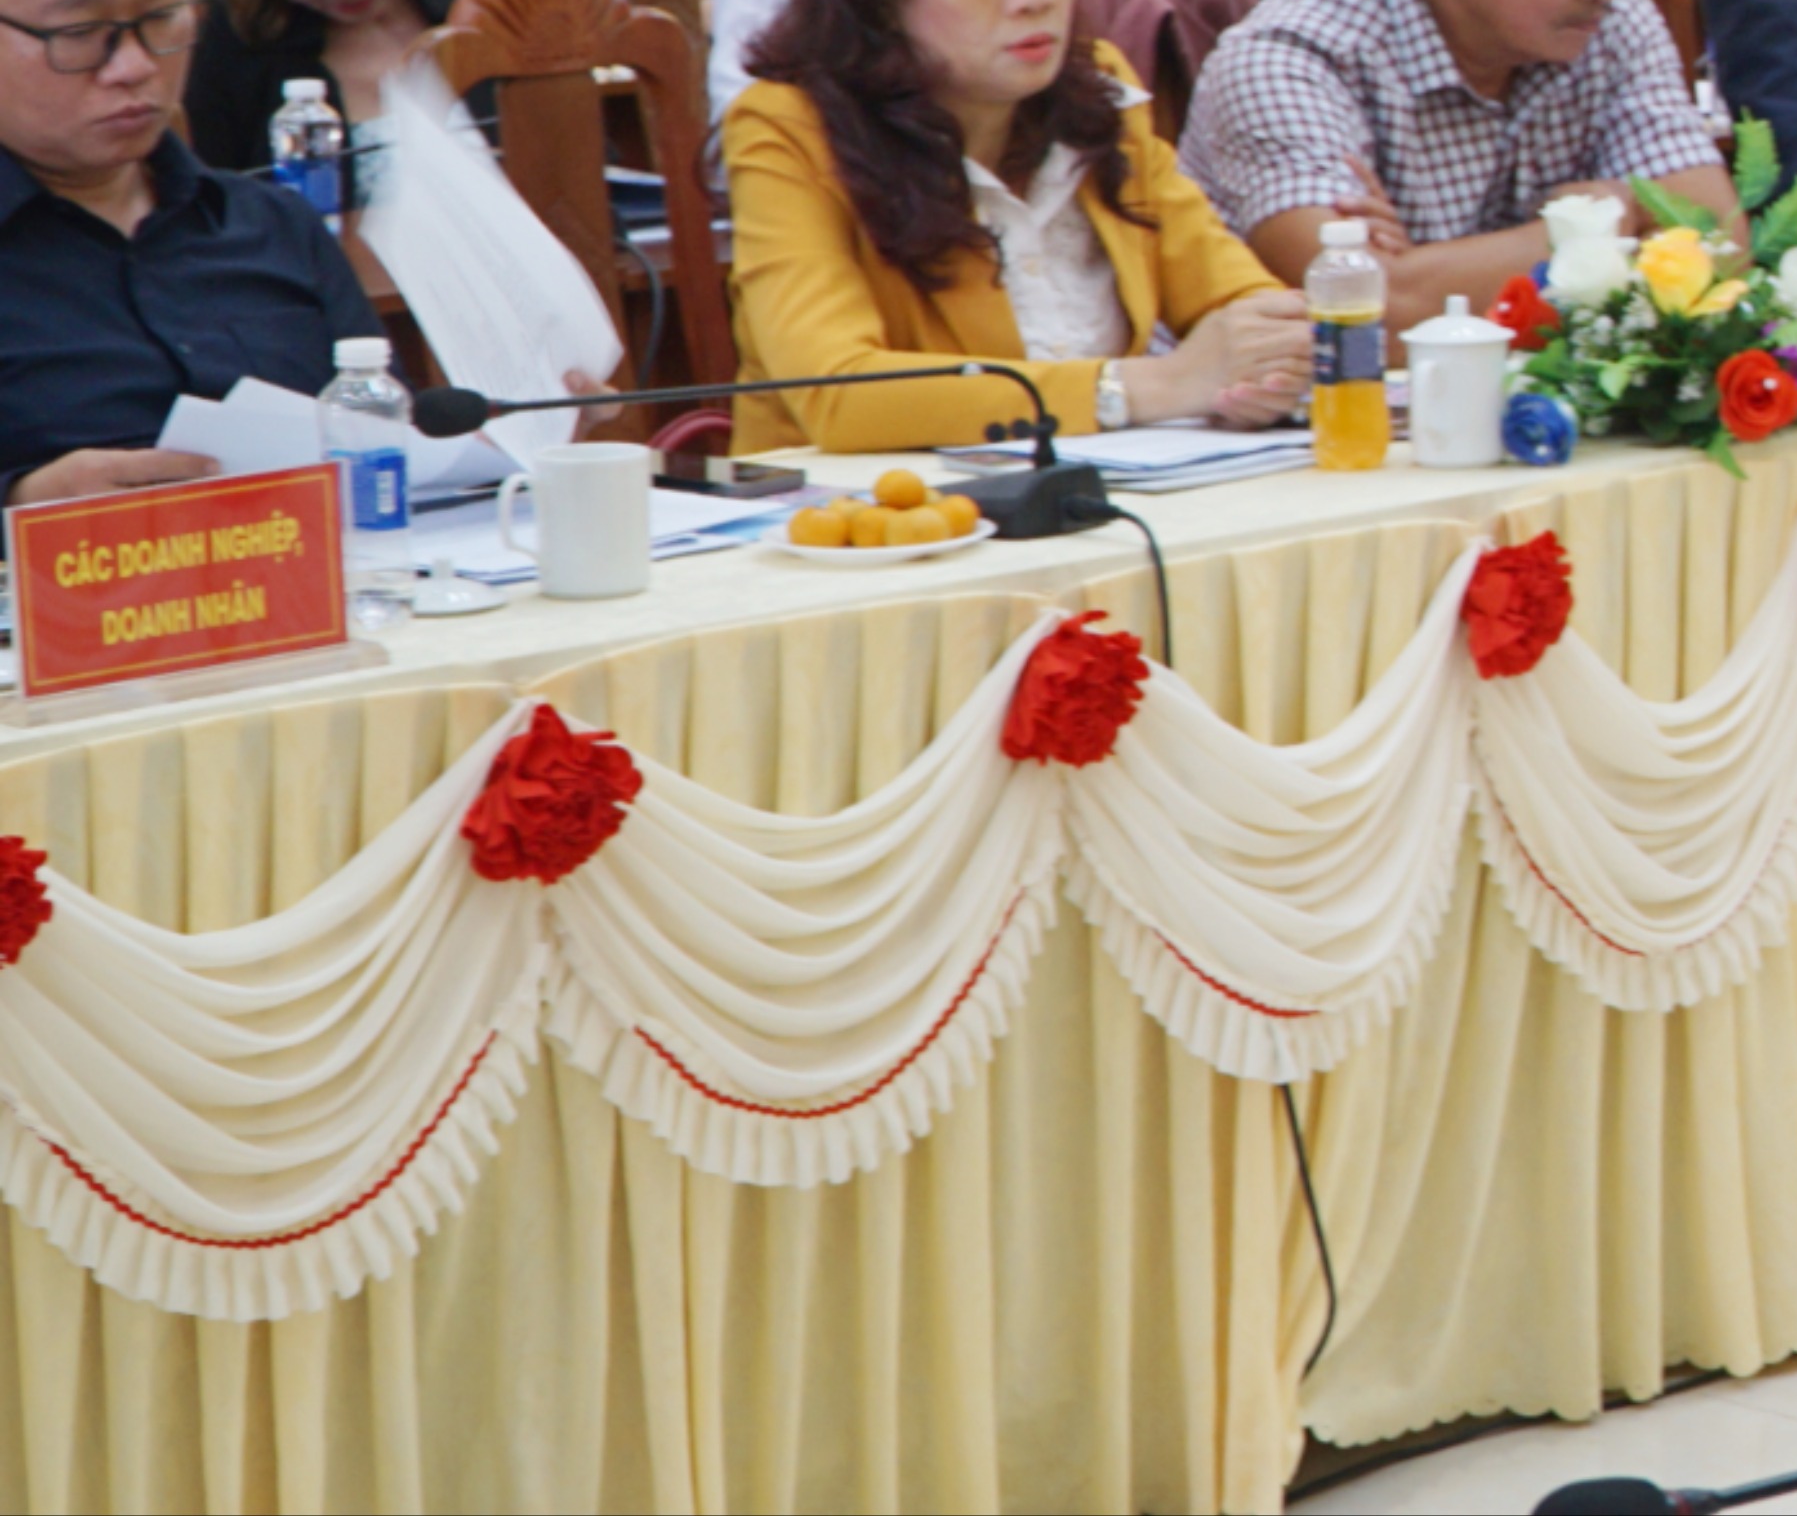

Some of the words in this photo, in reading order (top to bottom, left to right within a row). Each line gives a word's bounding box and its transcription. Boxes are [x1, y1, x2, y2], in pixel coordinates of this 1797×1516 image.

[54, 539, 114, 588] CÁC
[116, 531, 207, 579] DOANH
[209, 509, 304, 564] NGHIỆP,
[101, 598, 192, 646] DOANH
[194, 580, 266, 630] NHÂN
